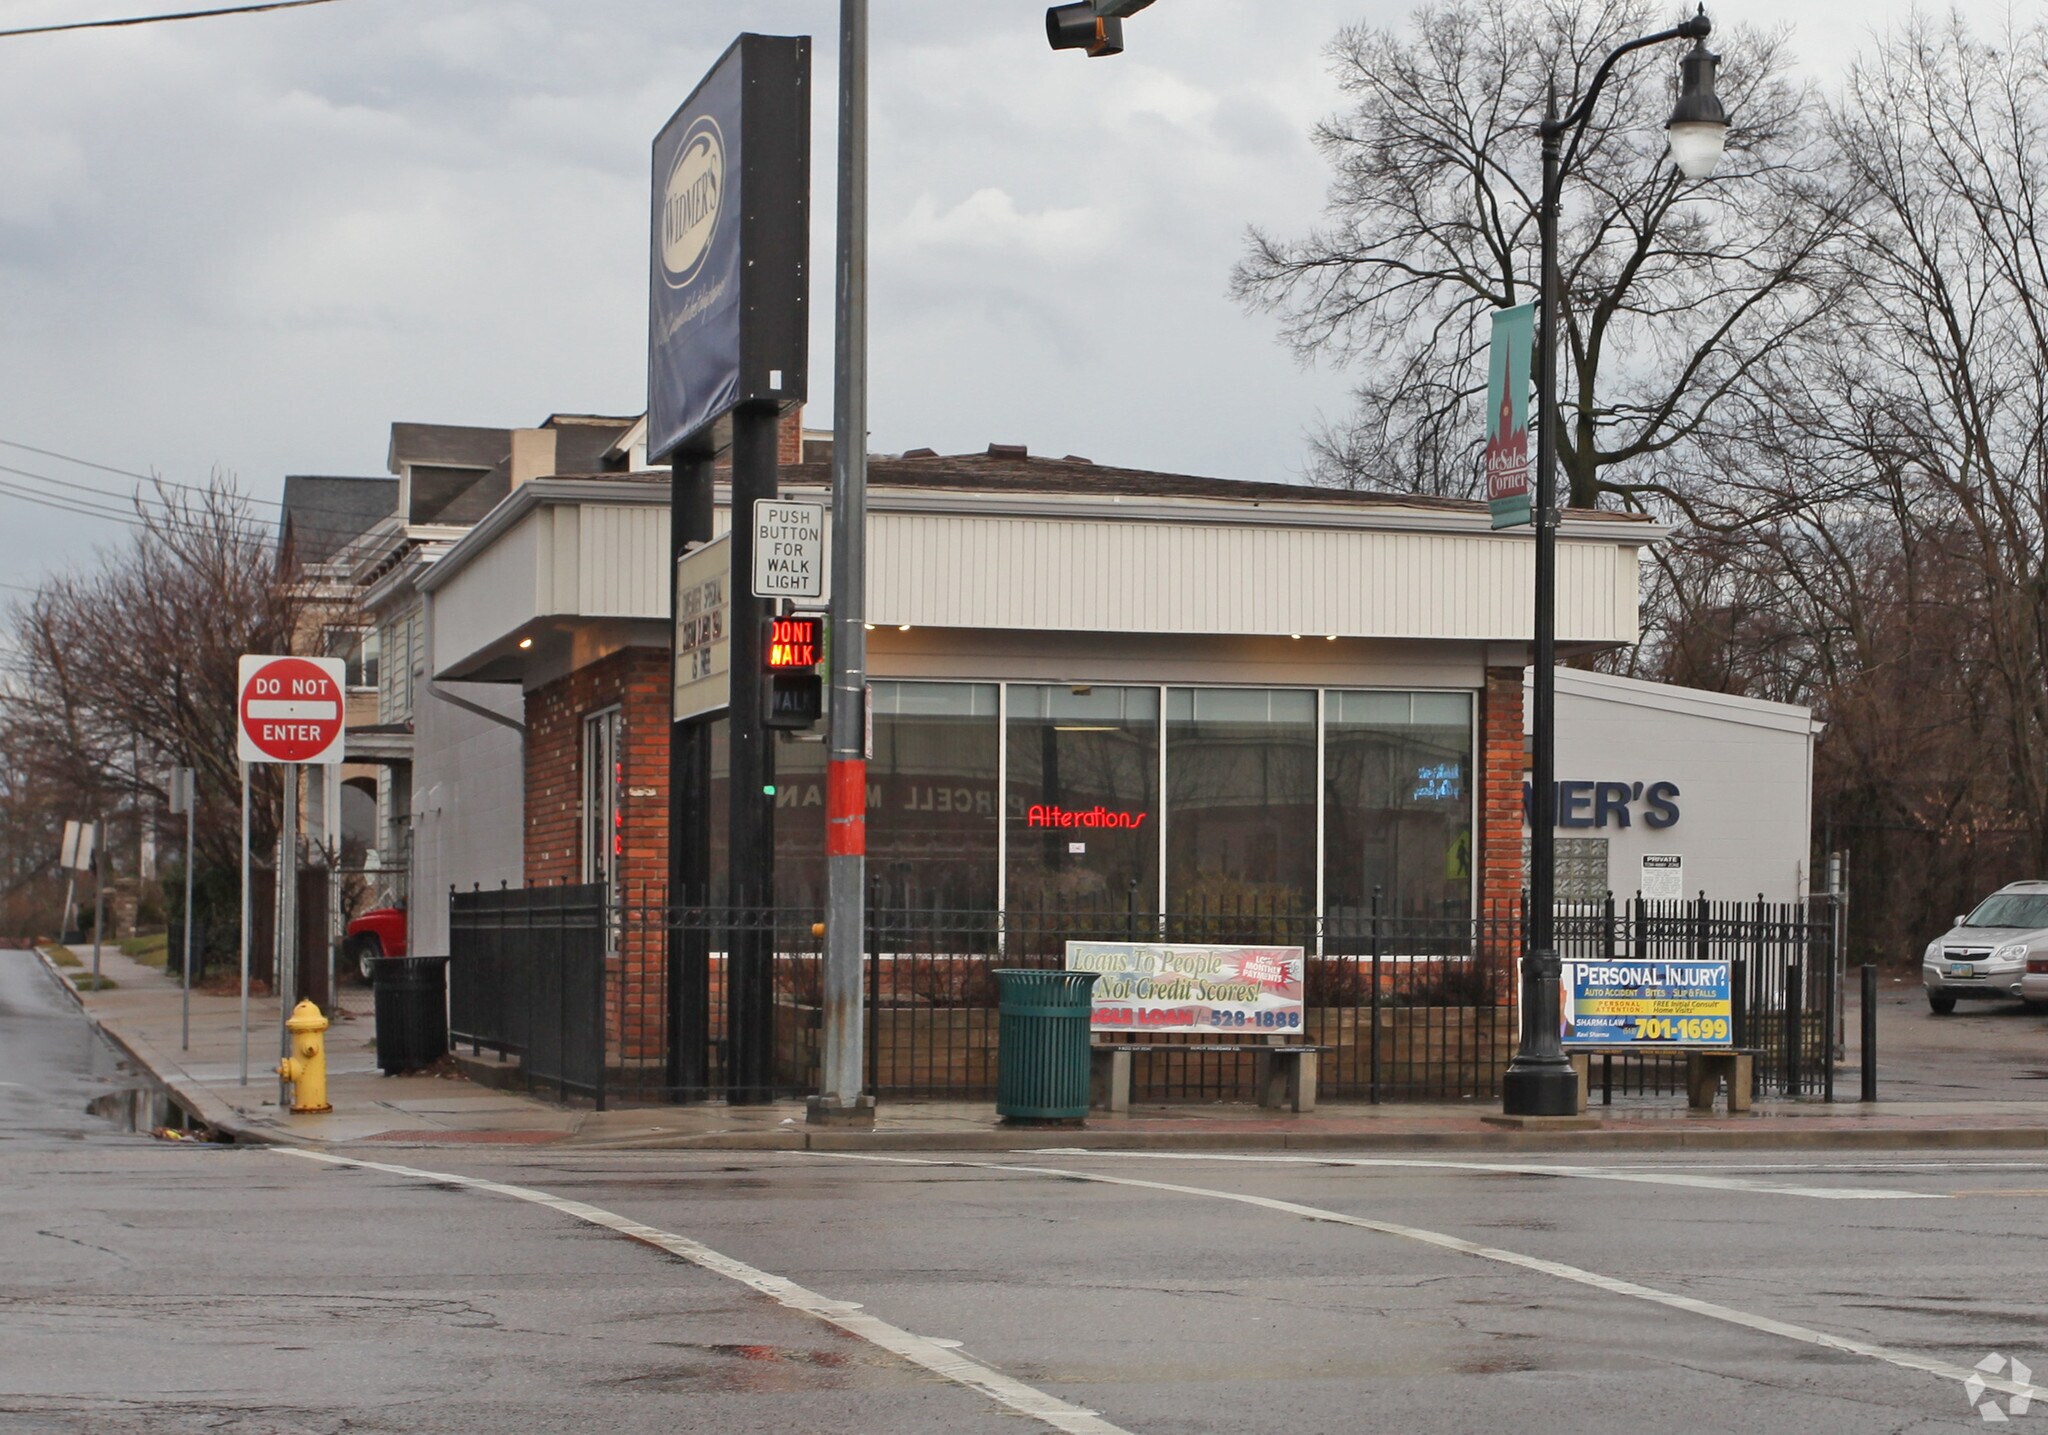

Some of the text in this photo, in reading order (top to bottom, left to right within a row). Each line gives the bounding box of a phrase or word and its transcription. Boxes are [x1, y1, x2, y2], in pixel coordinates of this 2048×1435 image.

[663, 153, 718, 249] WIDMER'S
[1488, 446, 1527, 472] deSales
[1488, 472, 1527, 498] Corner
[768, 509, 811, 524] PUSH
[760, 525, 819, 542] BUTTON
[774, 542, 803, 557] FOR
[767, 558, 810, 573] WALK
[766, 575, 810, 590] LIGHT
[771, 621, 813, 643] DONT
[770, 644, 814, 665] WALK
[256, 678, 329, 695] DO NOT
[262, 724, 321, 741] ENTER
[1027, 804, 1148, 829] Alterations
[1071, 948, 1222, 980] Loans To People
[1245, 961, 1283, 974] MONTHLY
[1242, 968, 1283, 983] PAYMENTS
[1576, 963, 1727, 987] PERSONAL INJURY?
[1136, 976, 1192, 1000] Credit
[1196, 979, 1262, 1002] Scores!
[1584, 988, 1604, 997] AUTO
[1604, 988, 1638, 997] ACCIDENT
[1644, 988, 1666, 998] BITES
[1695, 988, 1717, 998] FALLS
[1137, 1007, 1195, 1027] LOAN
[1576, 1018, 1626, 1027] SHARMA LAW
[1634, 1018, 1728, 1040] 701-1699
